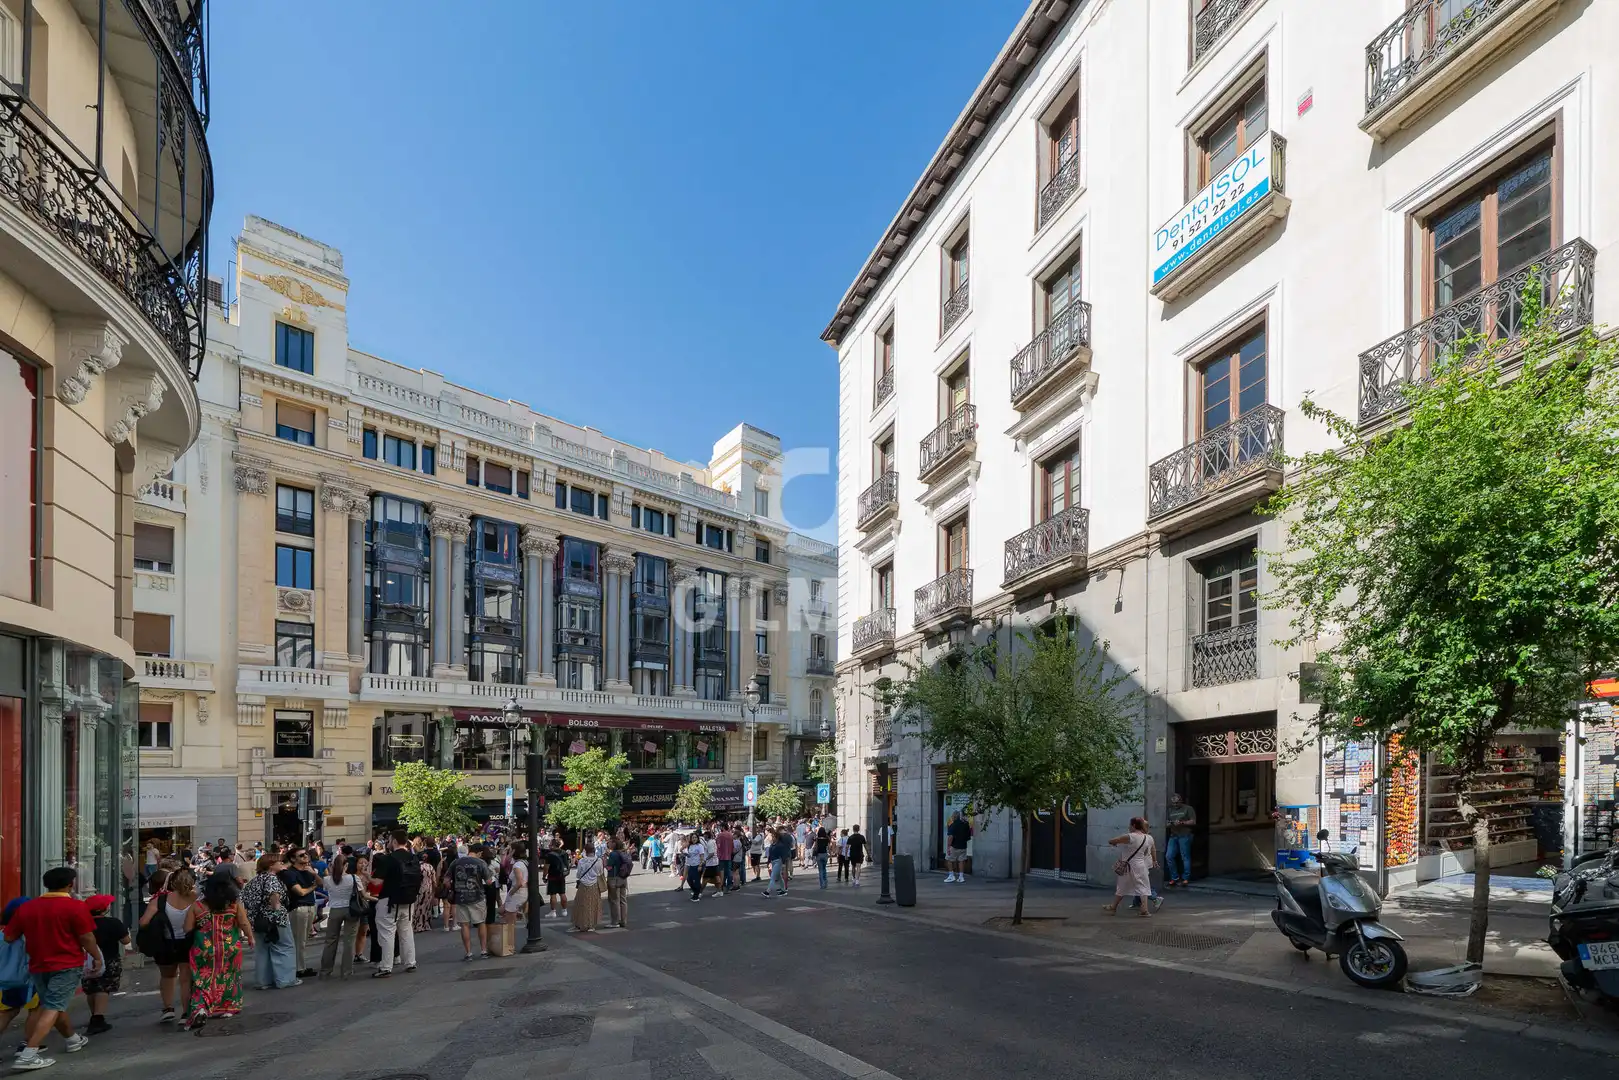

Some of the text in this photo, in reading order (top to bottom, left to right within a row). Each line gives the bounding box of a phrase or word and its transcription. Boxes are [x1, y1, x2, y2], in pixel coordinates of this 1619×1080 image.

[1172, 183, 1245, 250] 91 521 22 22
[1161, 191, 1259, 273] www.dentalsol.es
[469, 714, 533, 724] MAYOEL
[568, 719, 599, 727] BOLSOS
[472, 783, 520, 792] TACO BEL
